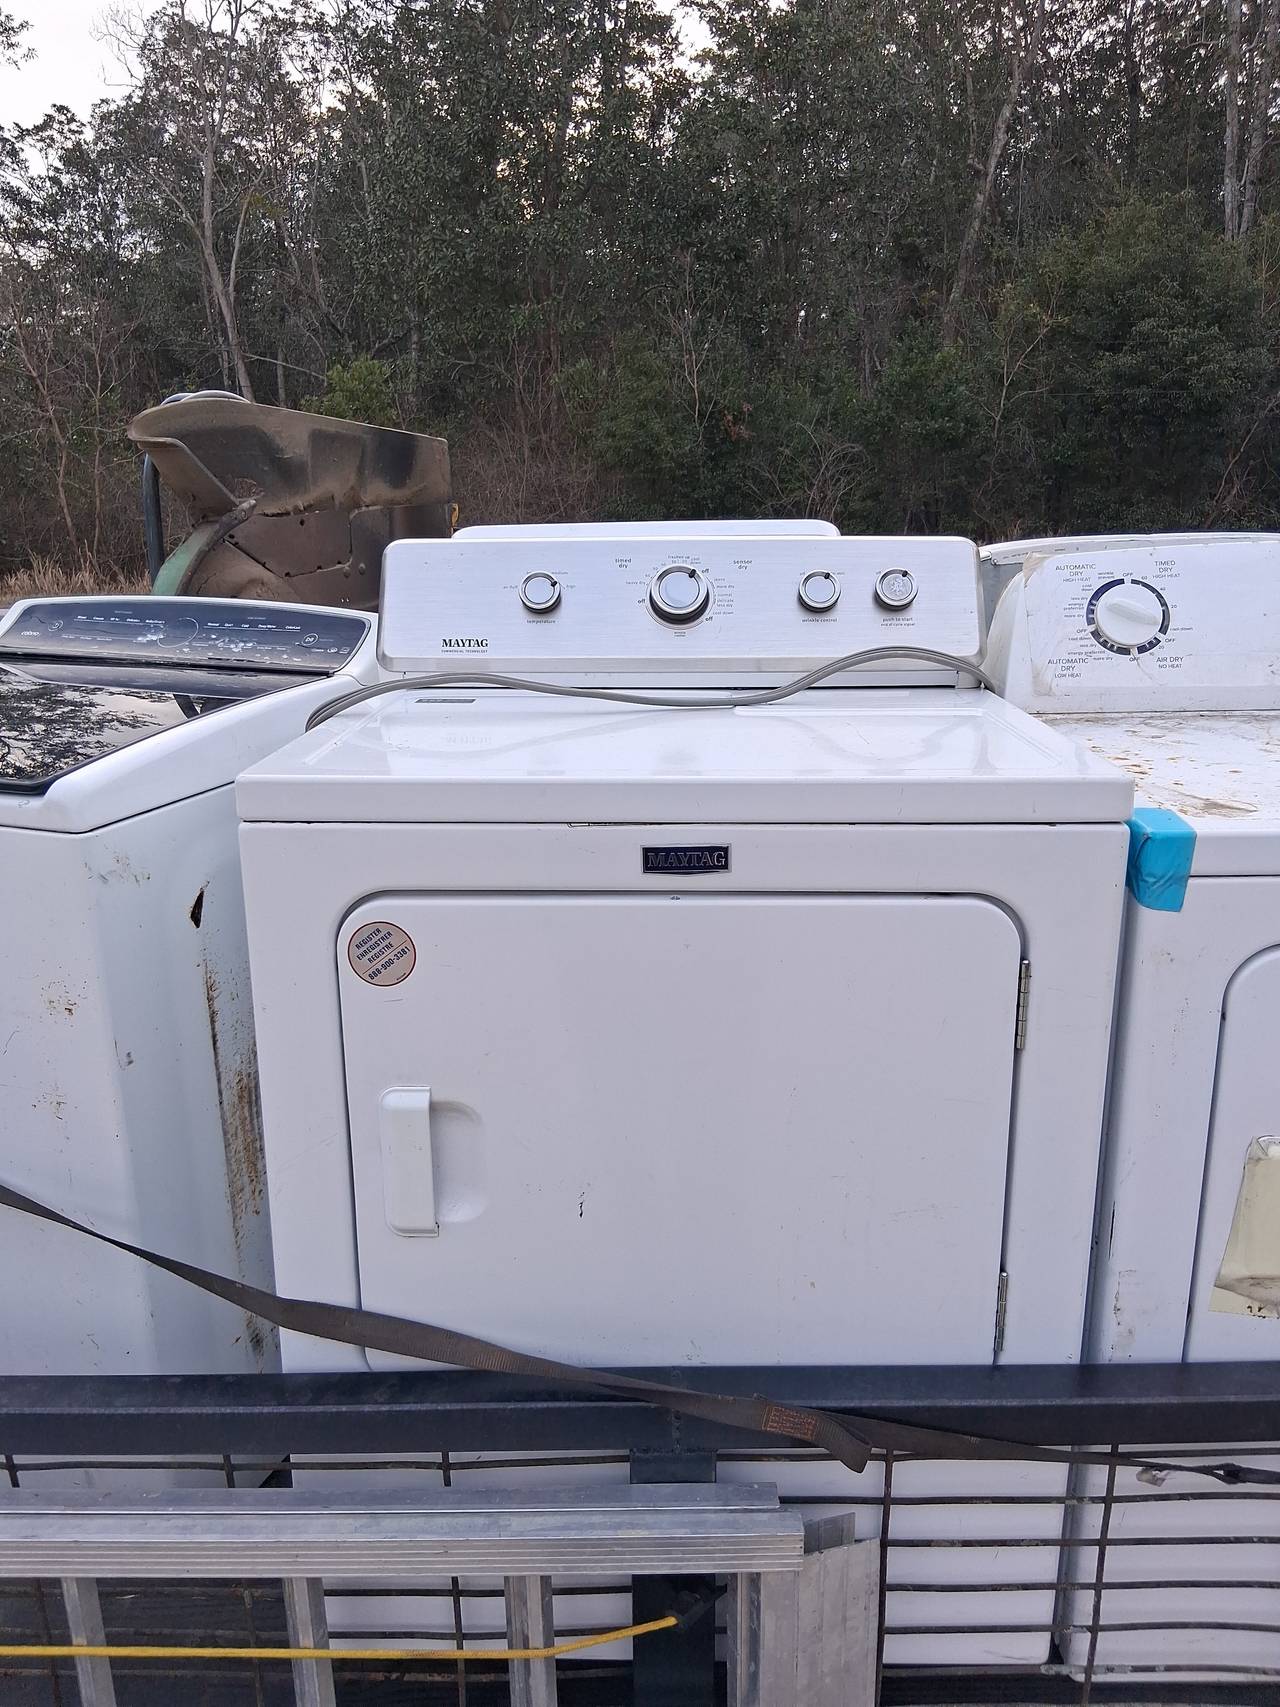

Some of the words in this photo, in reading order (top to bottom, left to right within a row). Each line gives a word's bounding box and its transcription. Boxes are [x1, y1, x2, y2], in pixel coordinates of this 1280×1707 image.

[1055, 563, 1096, 571] AUTOMATIC
[441, 638, 489, 648] MAYTAG
[1047, 657, 1089, 665] AUTOMATIC
[647, 851, 726, 868] MAYTAG
[355, 927, 382, 950] REGISTER
[356, 931, 393, 961] ENREGISTRER
[367, 941, 394, 964] REGISTRE
[368, 946, 411, 981] 888-900-3381
